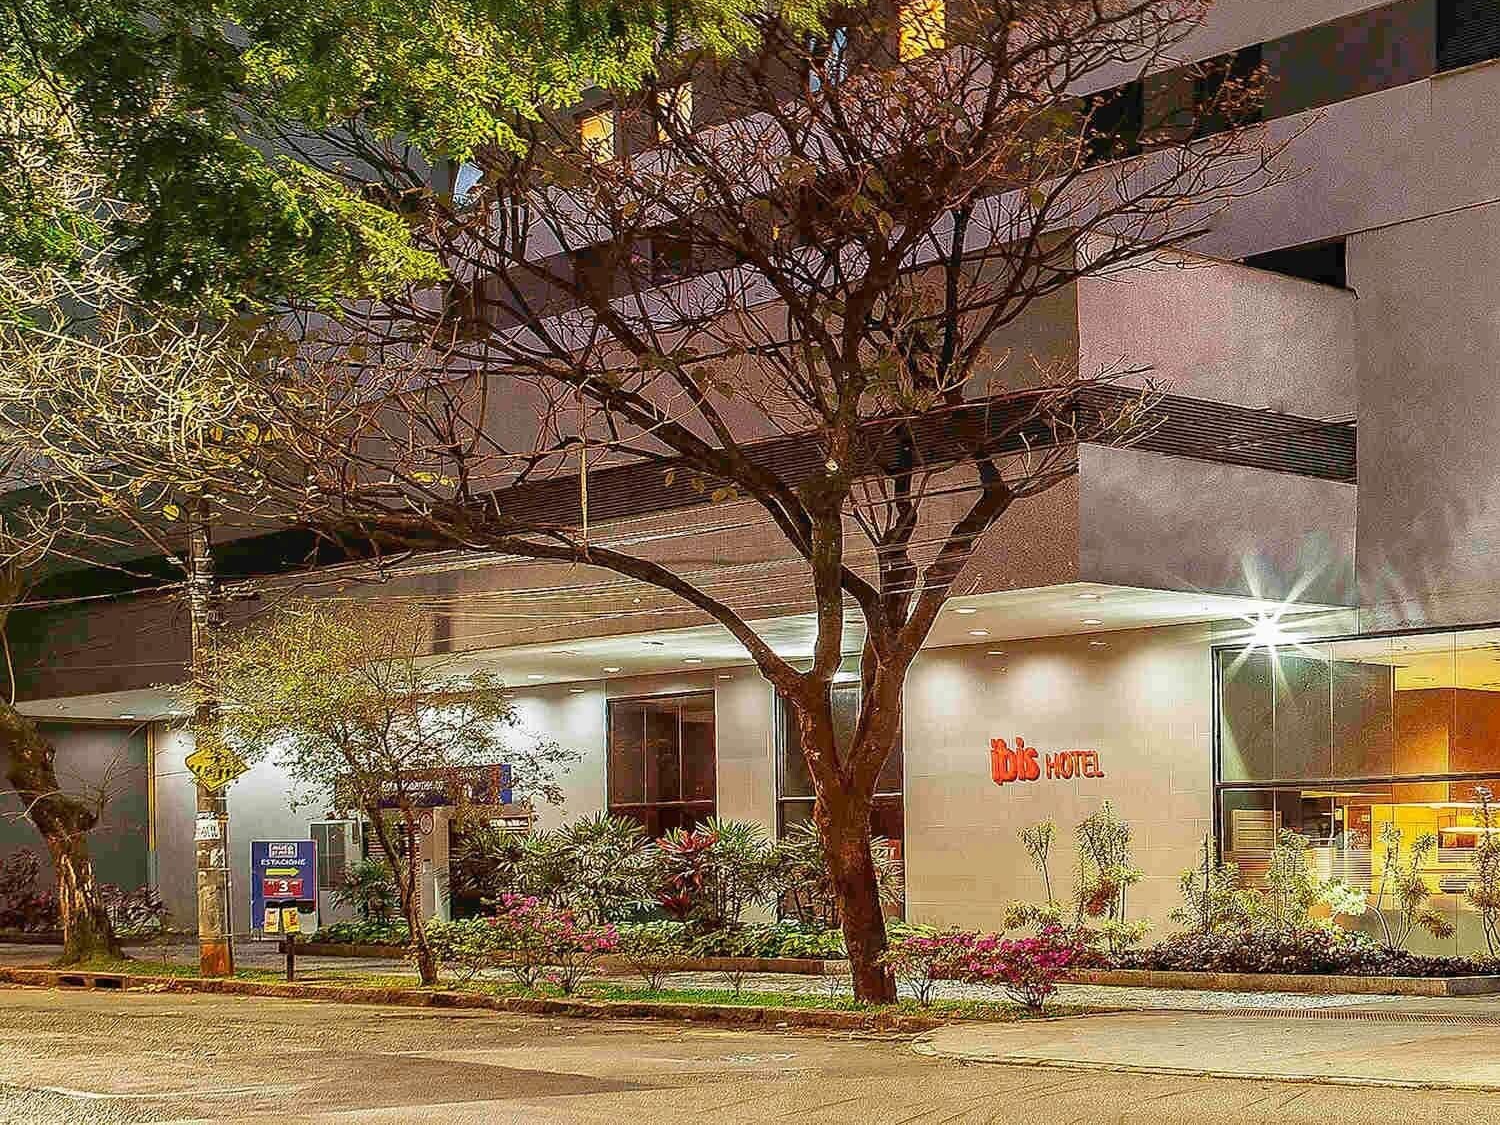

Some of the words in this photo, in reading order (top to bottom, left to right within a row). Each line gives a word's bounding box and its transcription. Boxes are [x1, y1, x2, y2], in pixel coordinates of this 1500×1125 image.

[990, 736, 1040, 786] ibis
[1046, 750, 1104, 779] HOTEL
[260, 858, 307, 866] ESTACIONE
